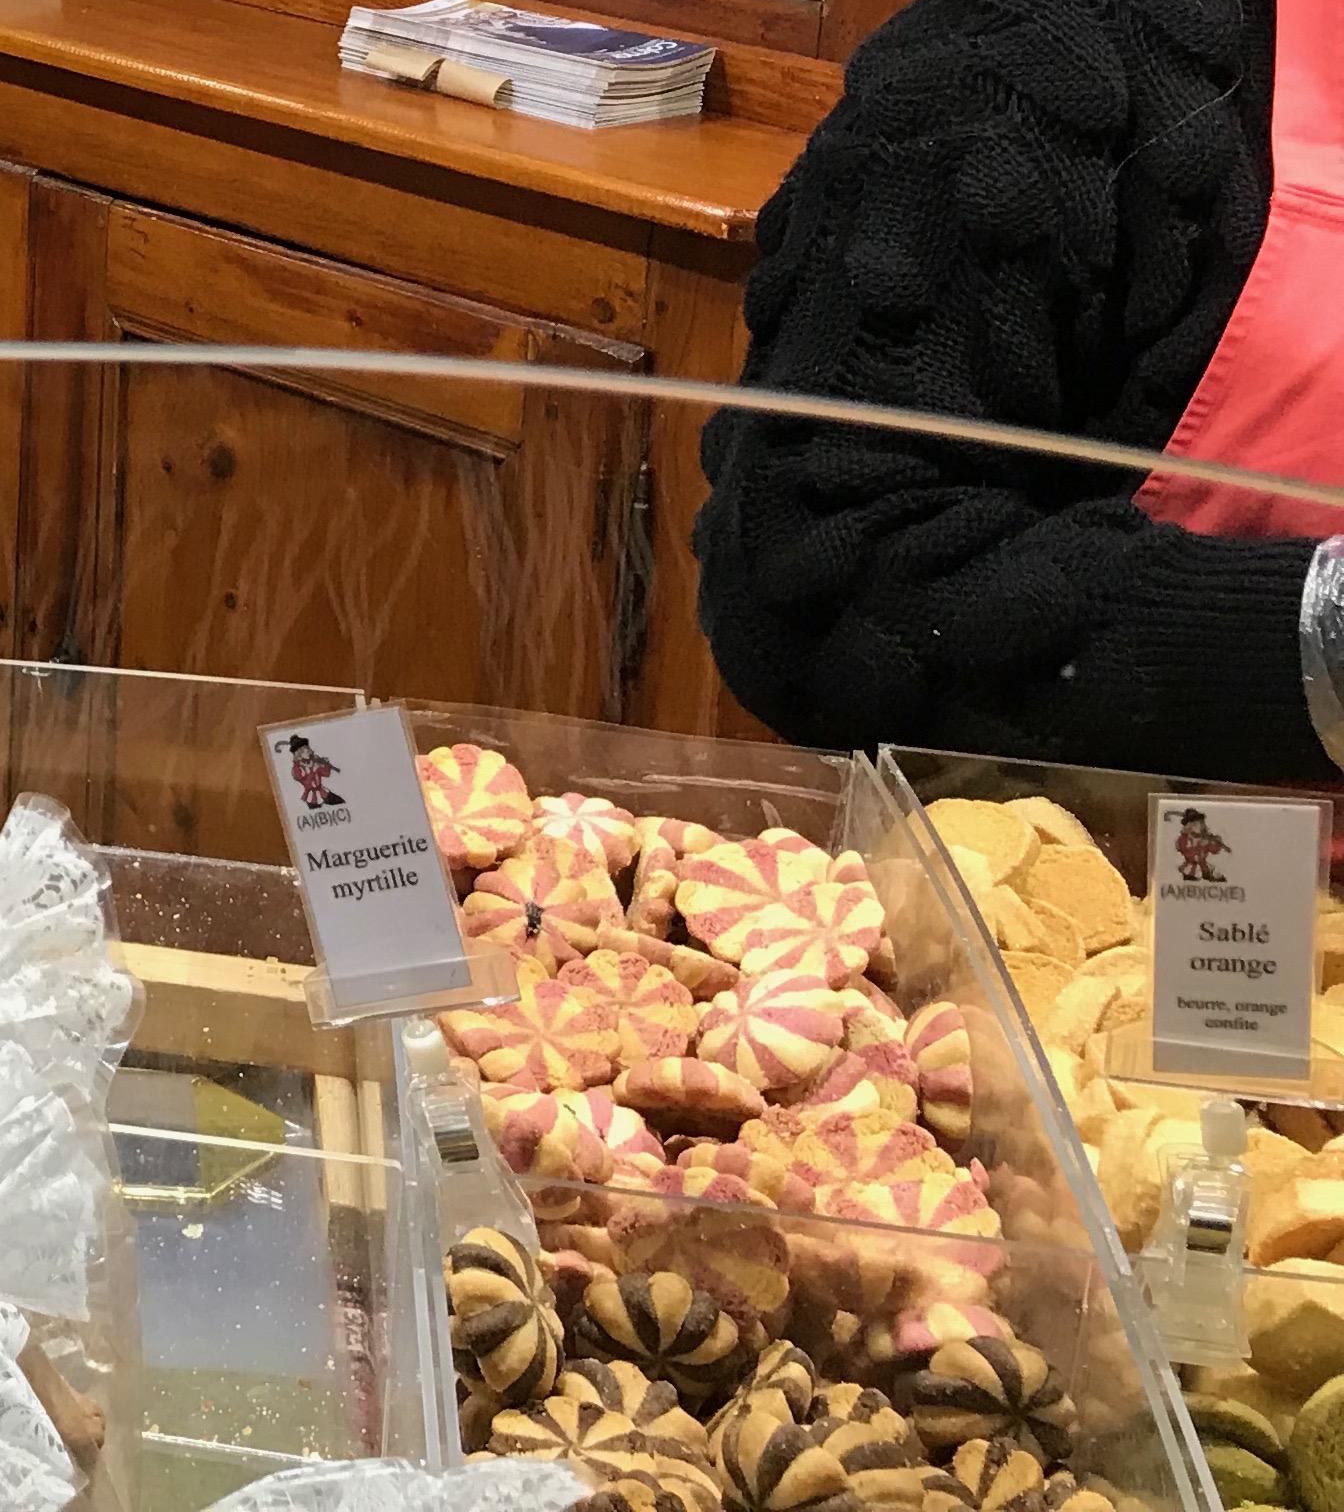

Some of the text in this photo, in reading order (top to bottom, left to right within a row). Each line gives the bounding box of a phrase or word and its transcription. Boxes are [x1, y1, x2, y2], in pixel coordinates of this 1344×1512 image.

[296, 807, 352, 832] (A)(B)(C)
[304, 834, 429, 872] Marguerite
[331, 867, 419, 901] myrtille
[1198, 921, 1270, 944] Sablé
[1189, 955, 1278, 979] orange
[1176, 996, 1288, 1017] beurre, orange
[1205, 1017, 1259, 1032] confite
